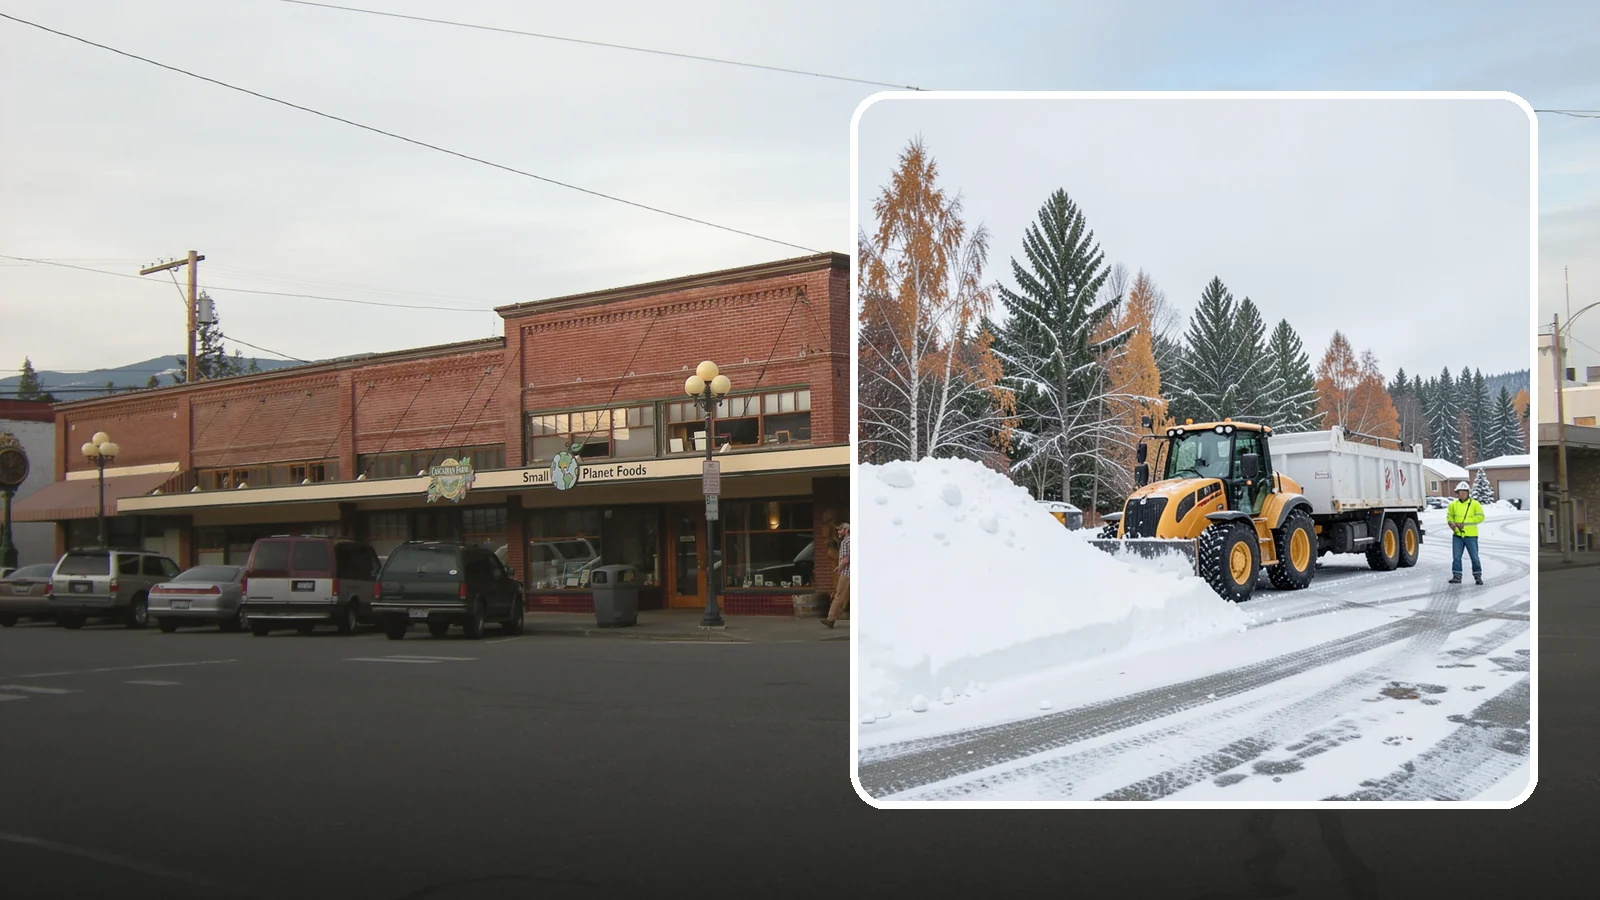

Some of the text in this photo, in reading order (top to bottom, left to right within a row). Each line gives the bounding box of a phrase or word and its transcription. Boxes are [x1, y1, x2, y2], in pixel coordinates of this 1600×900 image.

[523, 464, 647, 483] Small Planet Foods
